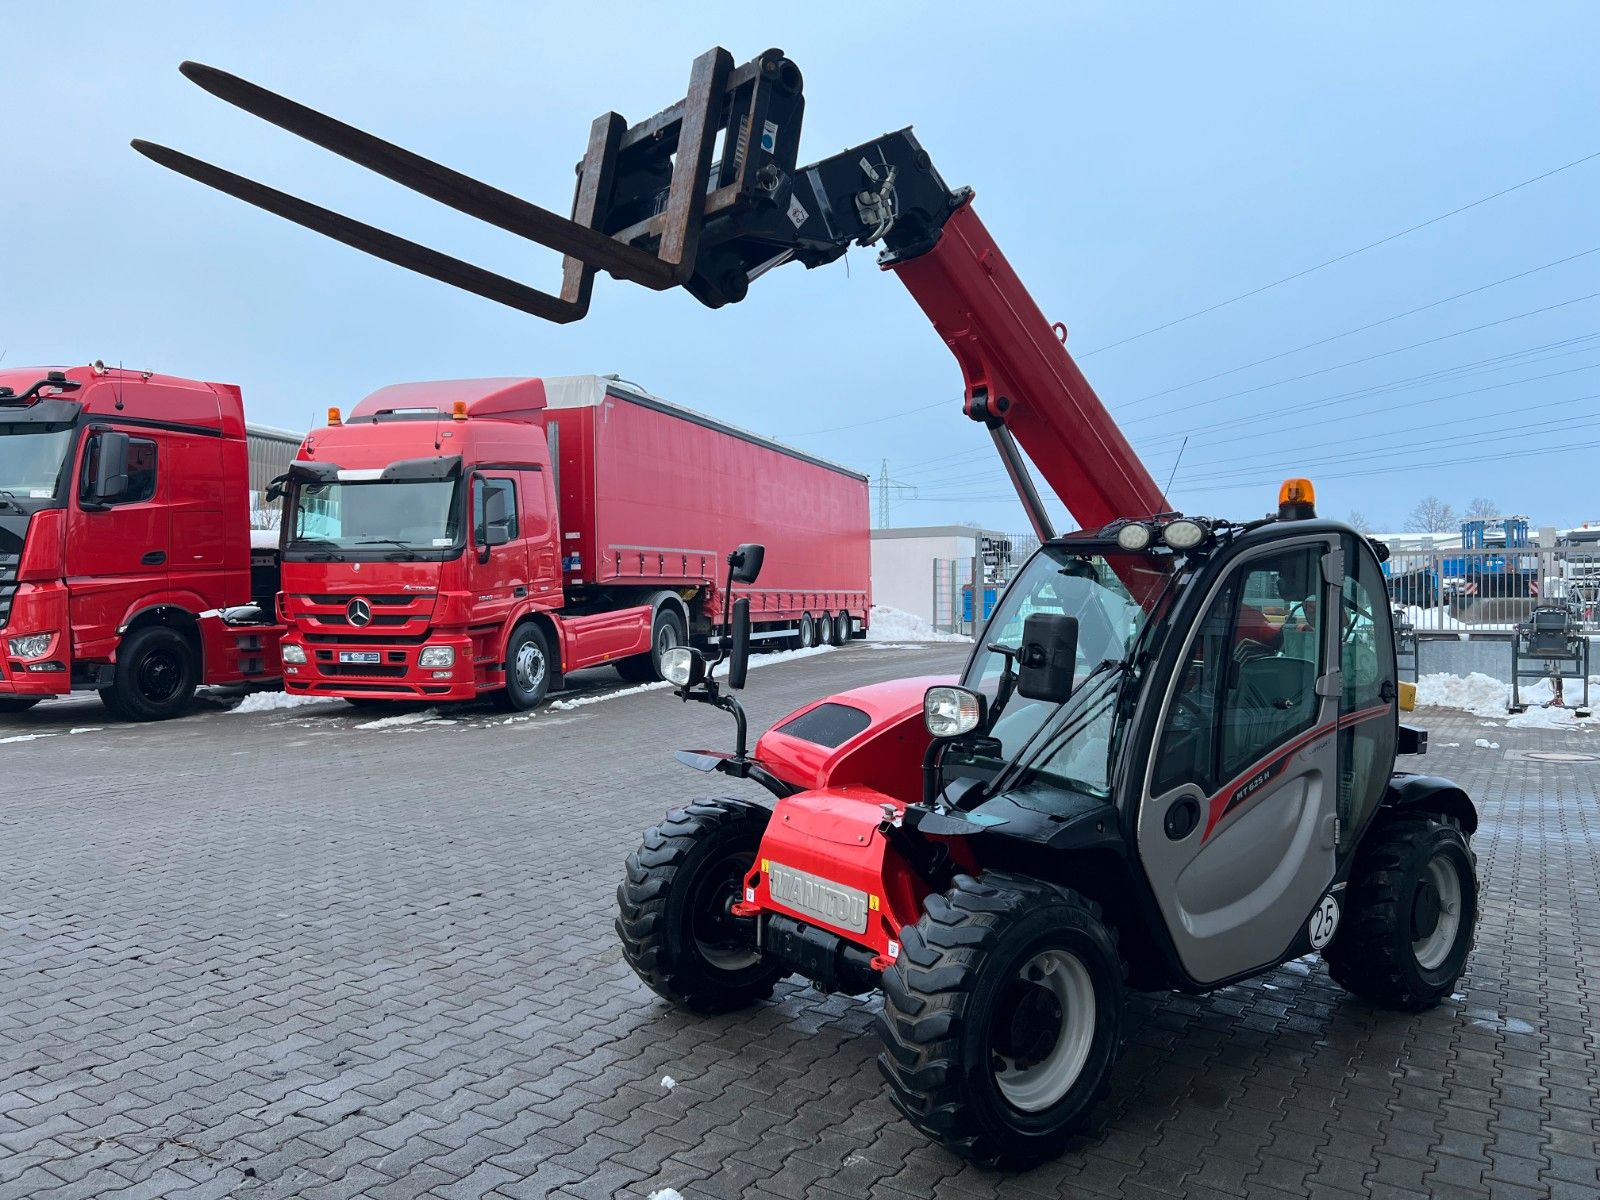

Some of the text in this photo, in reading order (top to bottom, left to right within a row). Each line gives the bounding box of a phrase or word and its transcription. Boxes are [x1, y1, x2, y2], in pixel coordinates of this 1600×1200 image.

[1236, 770, 1270, 801] MT 625 H
[773, 869, 866, 927] MANITOU
[1313, 903, 1334, 942] 25
